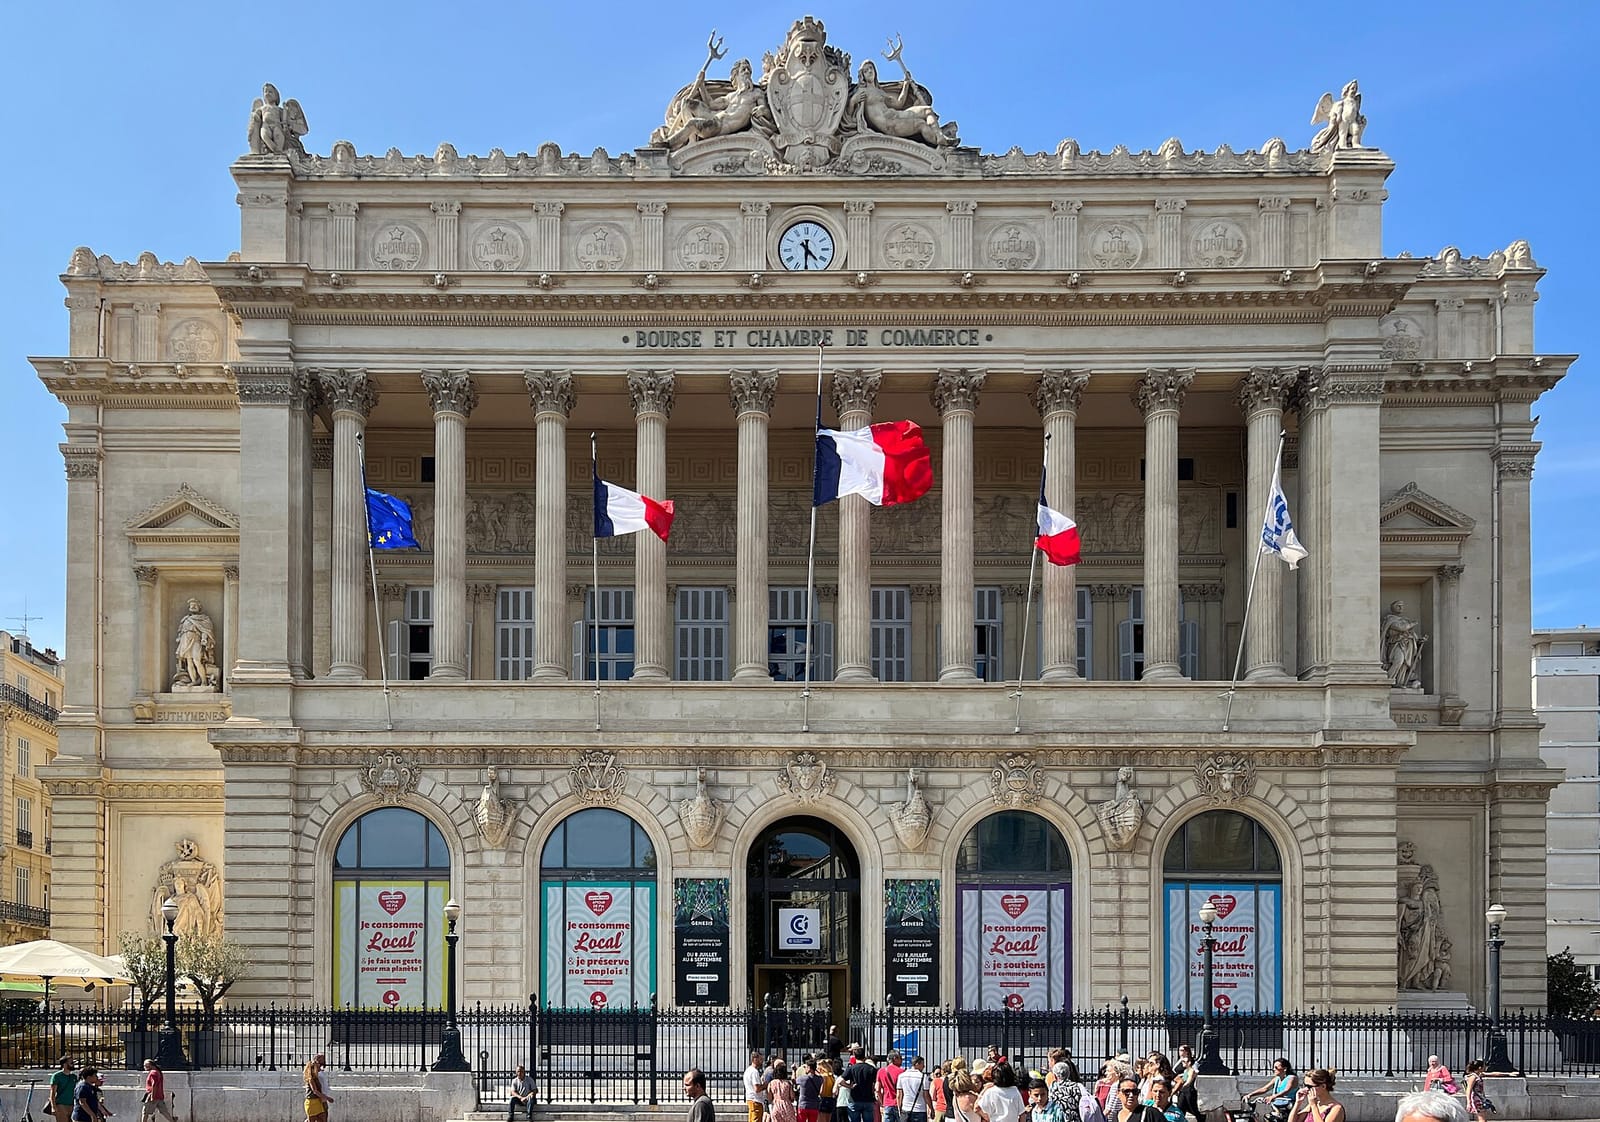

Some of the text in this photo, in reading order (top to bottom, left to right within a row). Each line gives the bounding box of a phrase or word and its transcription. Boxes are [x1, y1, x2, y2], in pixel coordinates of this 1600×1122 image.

[683, 242, 724, 255] COLOMB
[1102, 240, 1130, 253] COOK
[635, 329, 979, 348] BOURSE ET CHAMBRE DE COMMERCE
[156, 711, 225, 721] EUTHYMENES
[360, 921, 370, 930] Je
[568, 922, 576, 930] Je
[983, 924, 992, 933] Je
[1190, 924, 1200, 934] Je
[366, 930, 417, 951] Local
[573, 930, 624, 952] Local
[989, 933, 1040, 955] Local
[1196, 934, 1248, 956] ocal
[576, 957, 585, 966] je
[587, 957, 629, 967] préserve
[993, 960, 1002, 970] je
[1004, 960, 1045, 969] soutiens
[587, 968, 623, 976] emplois
